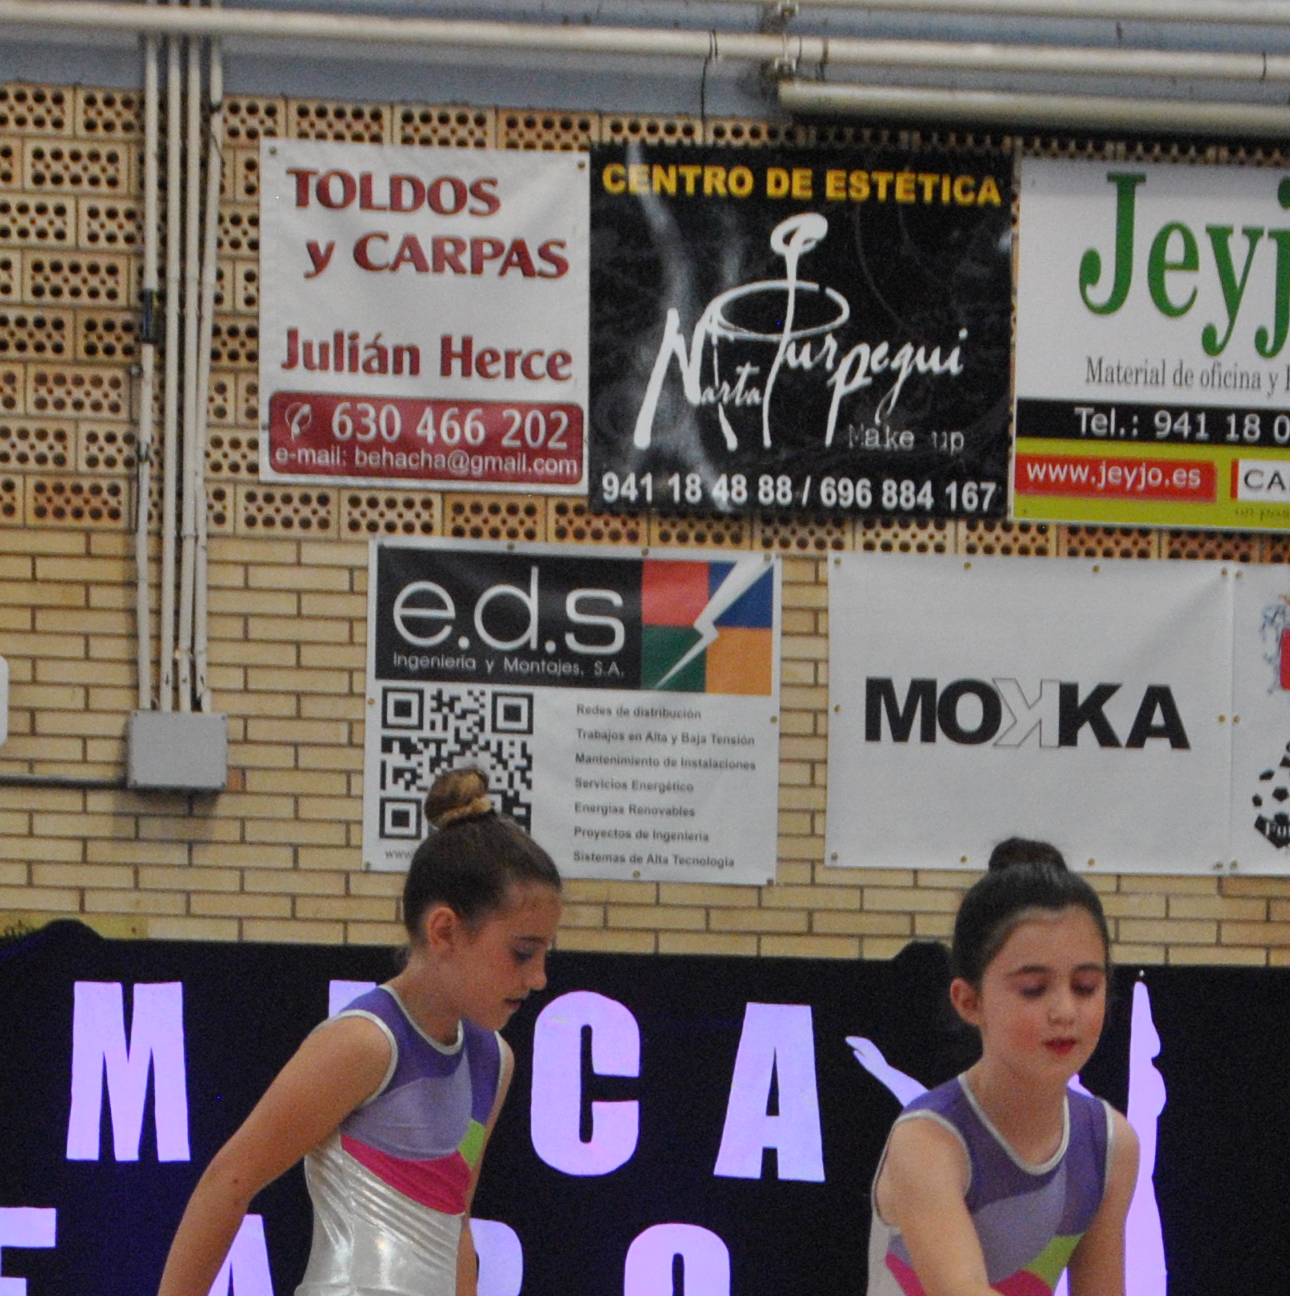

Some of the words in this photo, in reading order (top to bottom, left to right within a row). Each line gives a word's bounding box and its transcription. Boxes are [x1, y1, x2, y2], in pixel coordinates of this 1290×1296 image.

[285, 167, 502, 217] TOLDOS
[601, 163, 755, 197] CENTRO
[766, 167, 814, 199] DE
[303, 240, 337, 280] y
[352, 232, 570, 280] CARPAS
[280, 327, 421, 376] Julián
[440, 334, 574, 382] Herce
[1085, 356, 1166, 387] Material
[1172, 361, 1195, 387] de
[1200, 362, 1262, 391] oficina
[1266, 372, 1278, 397] y
[331, 401, 402, 442] 630
[416, 405, 486, 446] 466
[500, 408, 569, 450] 202
[1074, 406, 1139, 438] Tel.:
[1153, 410, 1209, 441] 941
[1226, 413, 1261, 443] 18
[275, 446, 347, 467] e-mail:
[354, 445, 578, 475] behacha@gmail.com
[1026, 460, 1202, 491] www.jeyjo.es
[602, 472, 654, 503] 941
[667, 473, 703, 502] 18
[711, 474, 748, 503] 48
[758, 475, 793, 504] 88
[820, 478, 873, 509] 696
[882, 480, 935, 511] 884
[945, 481, 997, 512] 167
[392, 566, 626, 656] e.d.s
[393, 652, 477, 673] Ingeniería
[485, 658, 495, 673] y
[576, 704, 612, 717] Redes
[616, 705, 630, 717] de
[633, 705, 702, 720] distribución
[576, 728, 625, 743] Trabajos
[628, 732, 643, 742] en
[645, 730, 668, 743] Alta
[671, 733, 678, 746] y
[681, 732, 707, 746] Baja
[711, 733, 756, 747] Tensión
[574, 752, 660, 768] Mantenimiento
[663, 755, 678, 768] de
[680, 756, 757, 772] Instalaciones
[574, 777, 628, 791] Servicios
[628, 804, 696, 818] Renovables
[573, 825, 632, 841] Proyectos
[635, 828, 649, 840] de
[573, 851, 626, 864] Sistemas
[629, 852, 643, 864] de
[646, 852, 669, 865] Alta
